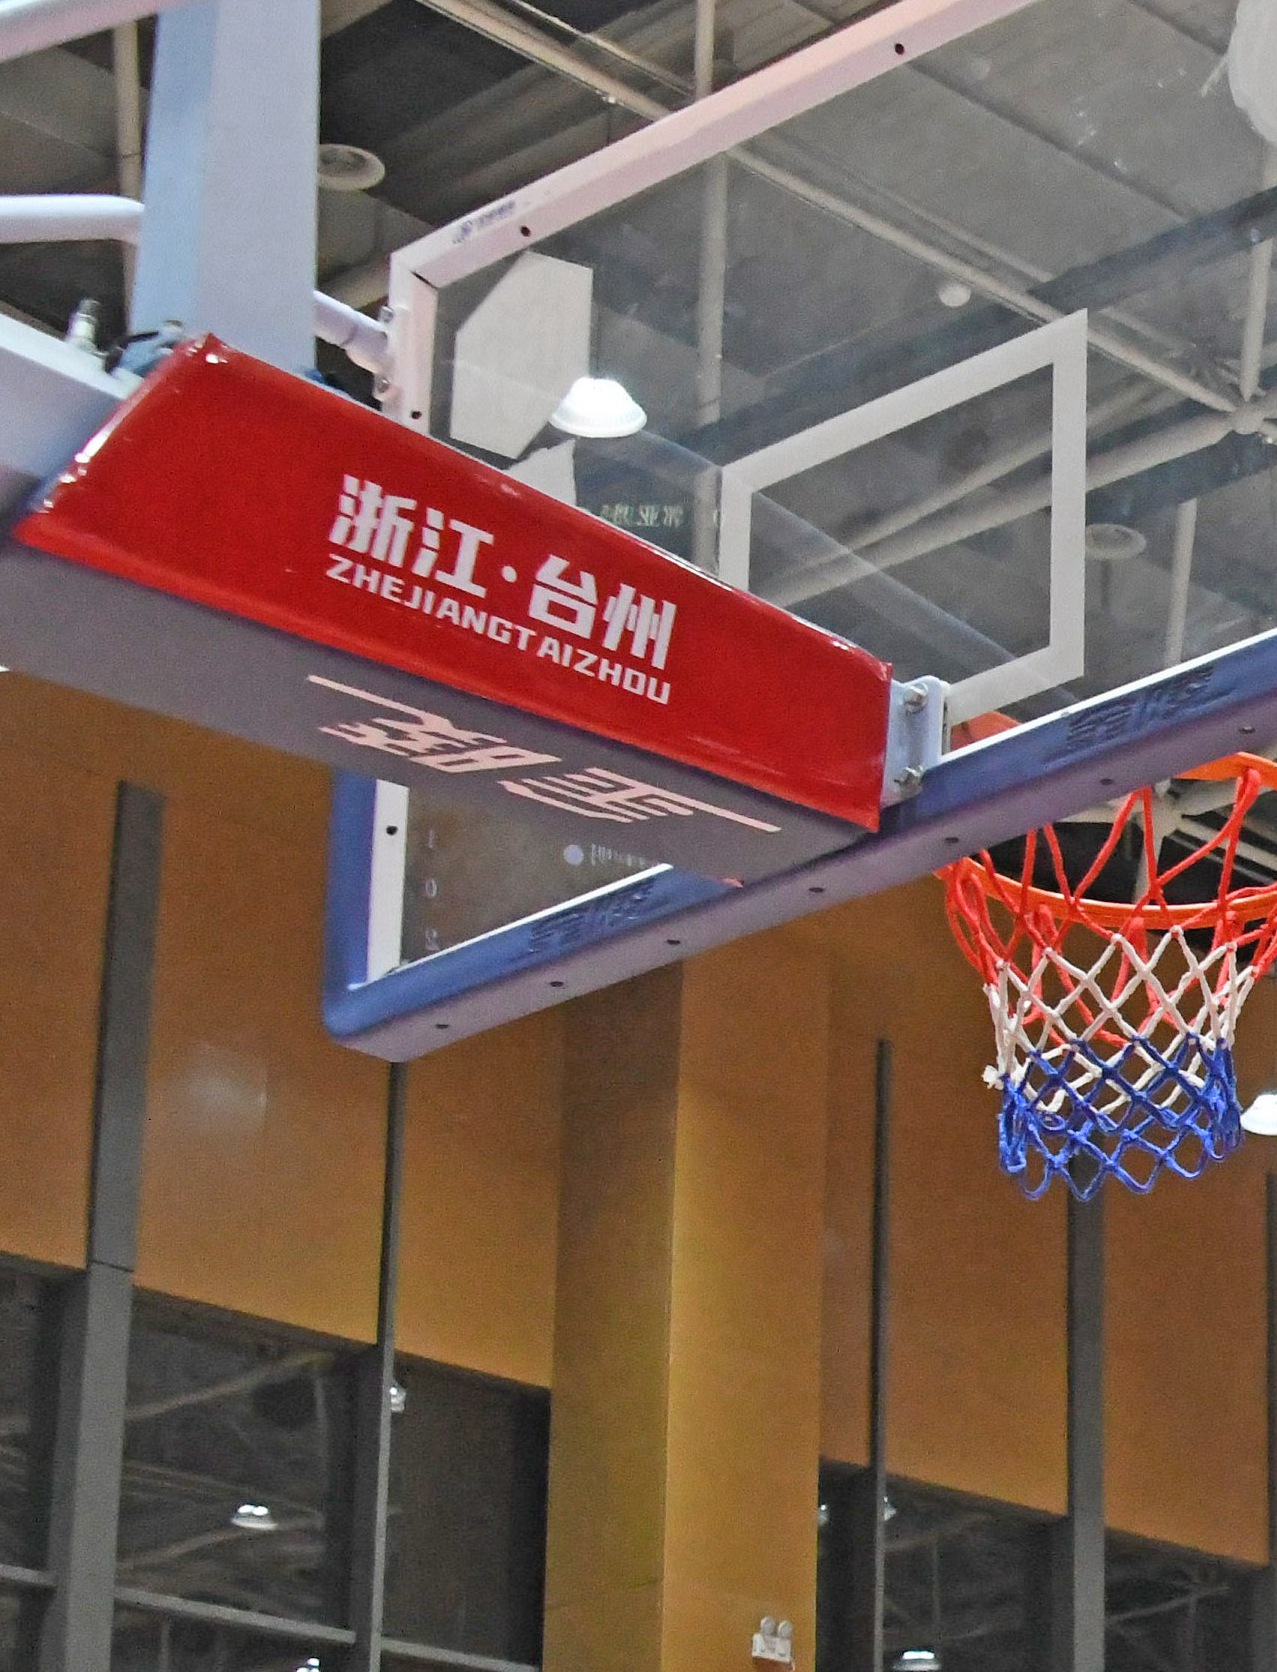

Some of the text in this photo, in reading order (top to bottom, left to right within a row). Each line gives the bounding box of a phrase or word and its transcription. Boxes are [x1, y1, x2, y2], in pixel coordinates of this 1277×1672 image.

[326, 553, 671, 705] ZHEJIANGTAIZHOU
[329, 473, 677, 670] 浙江·台州
